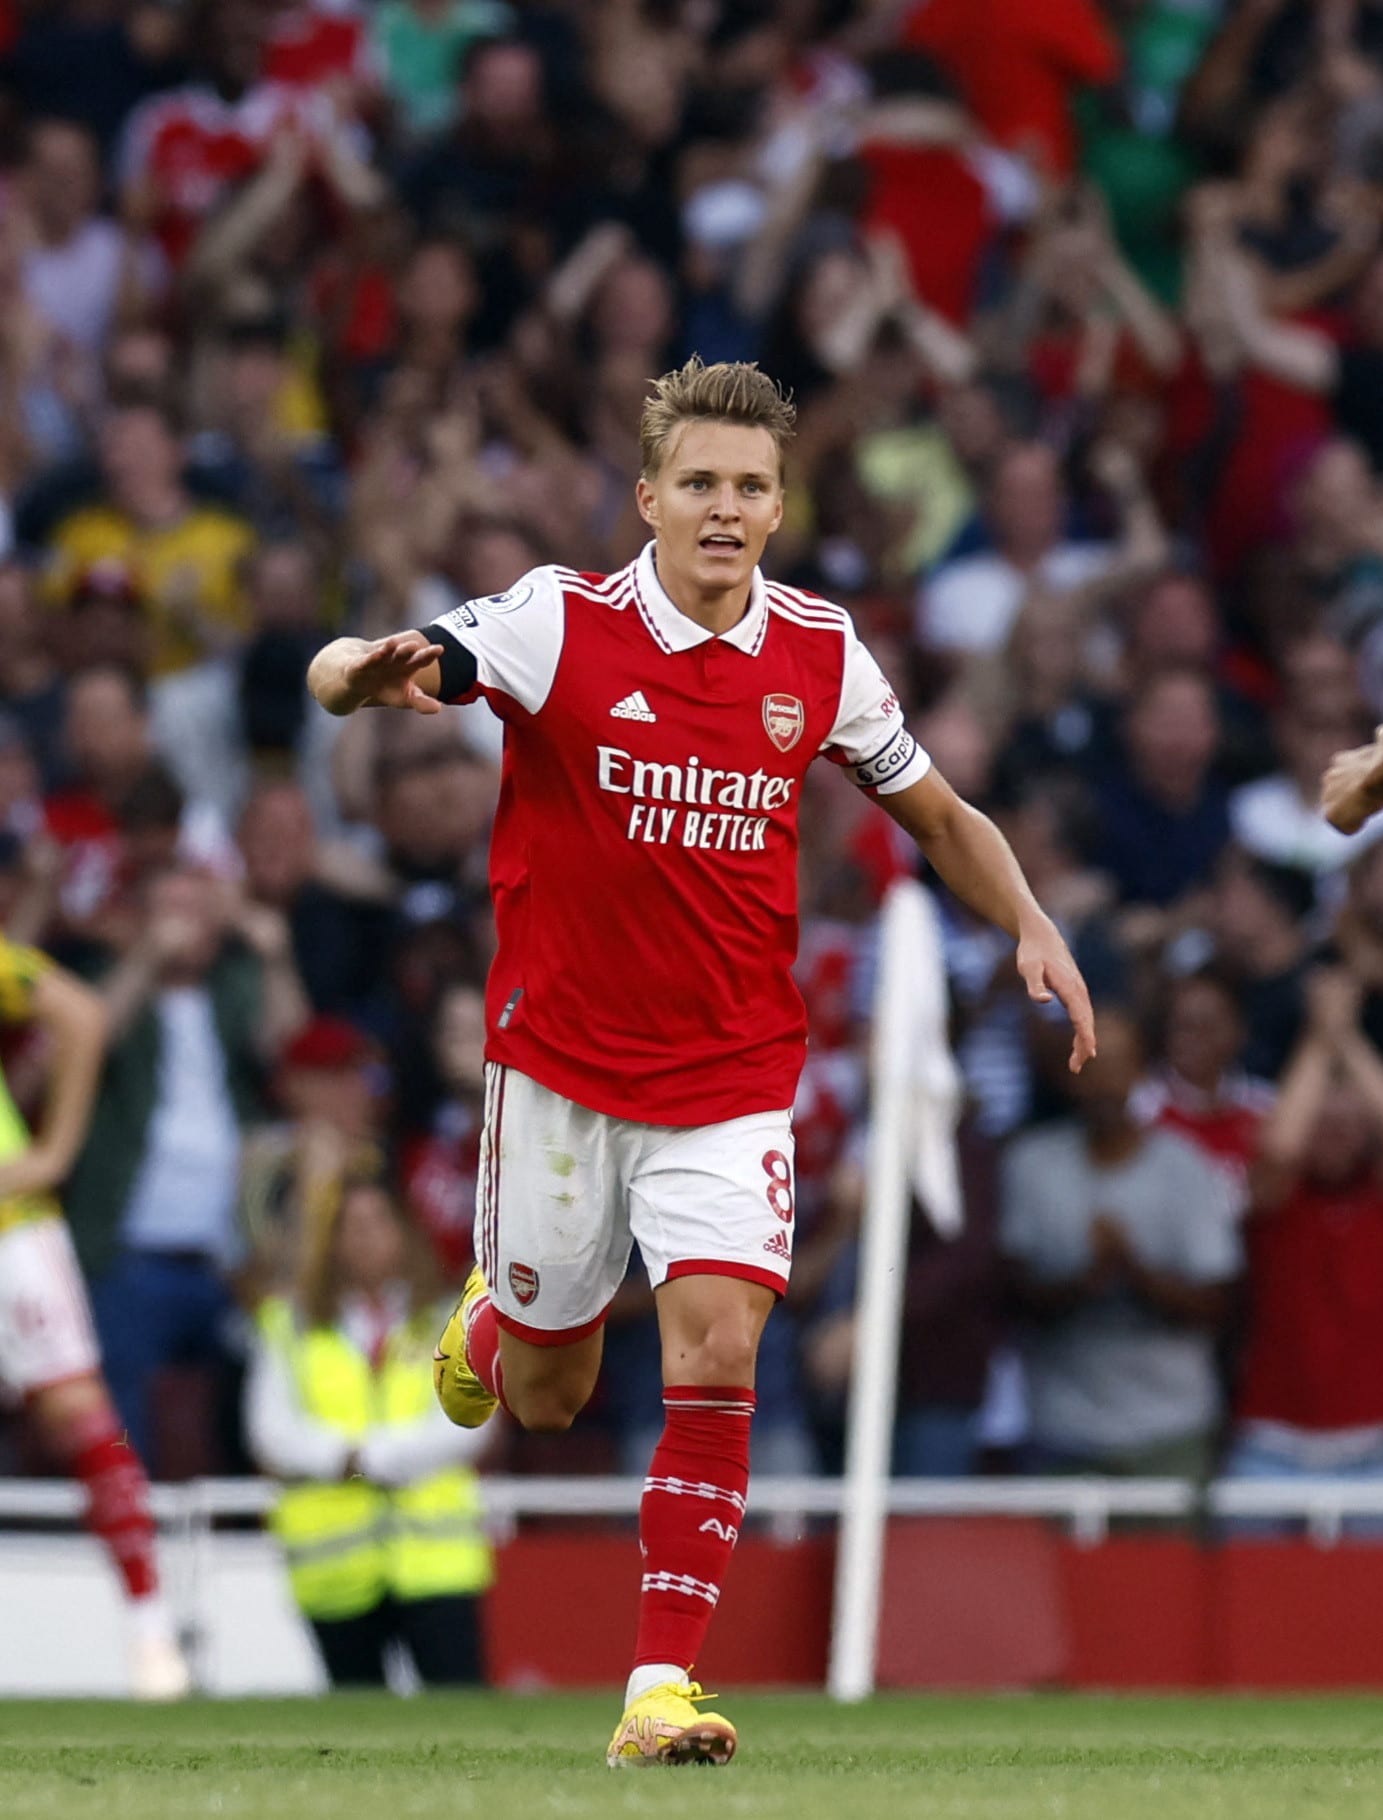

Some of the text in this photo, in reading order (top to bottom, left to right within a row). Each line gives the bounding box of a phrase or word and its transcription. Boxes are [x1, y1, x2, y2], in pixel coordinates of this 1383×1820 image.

[609, 706, 657, 723] adidas
[875, 733, 910, 774] Capt
[596, 745, 795, 811] Emirates
[627, 803, 770, 851] FLY BETTER
[761, 1149, 793, 1224] 8
